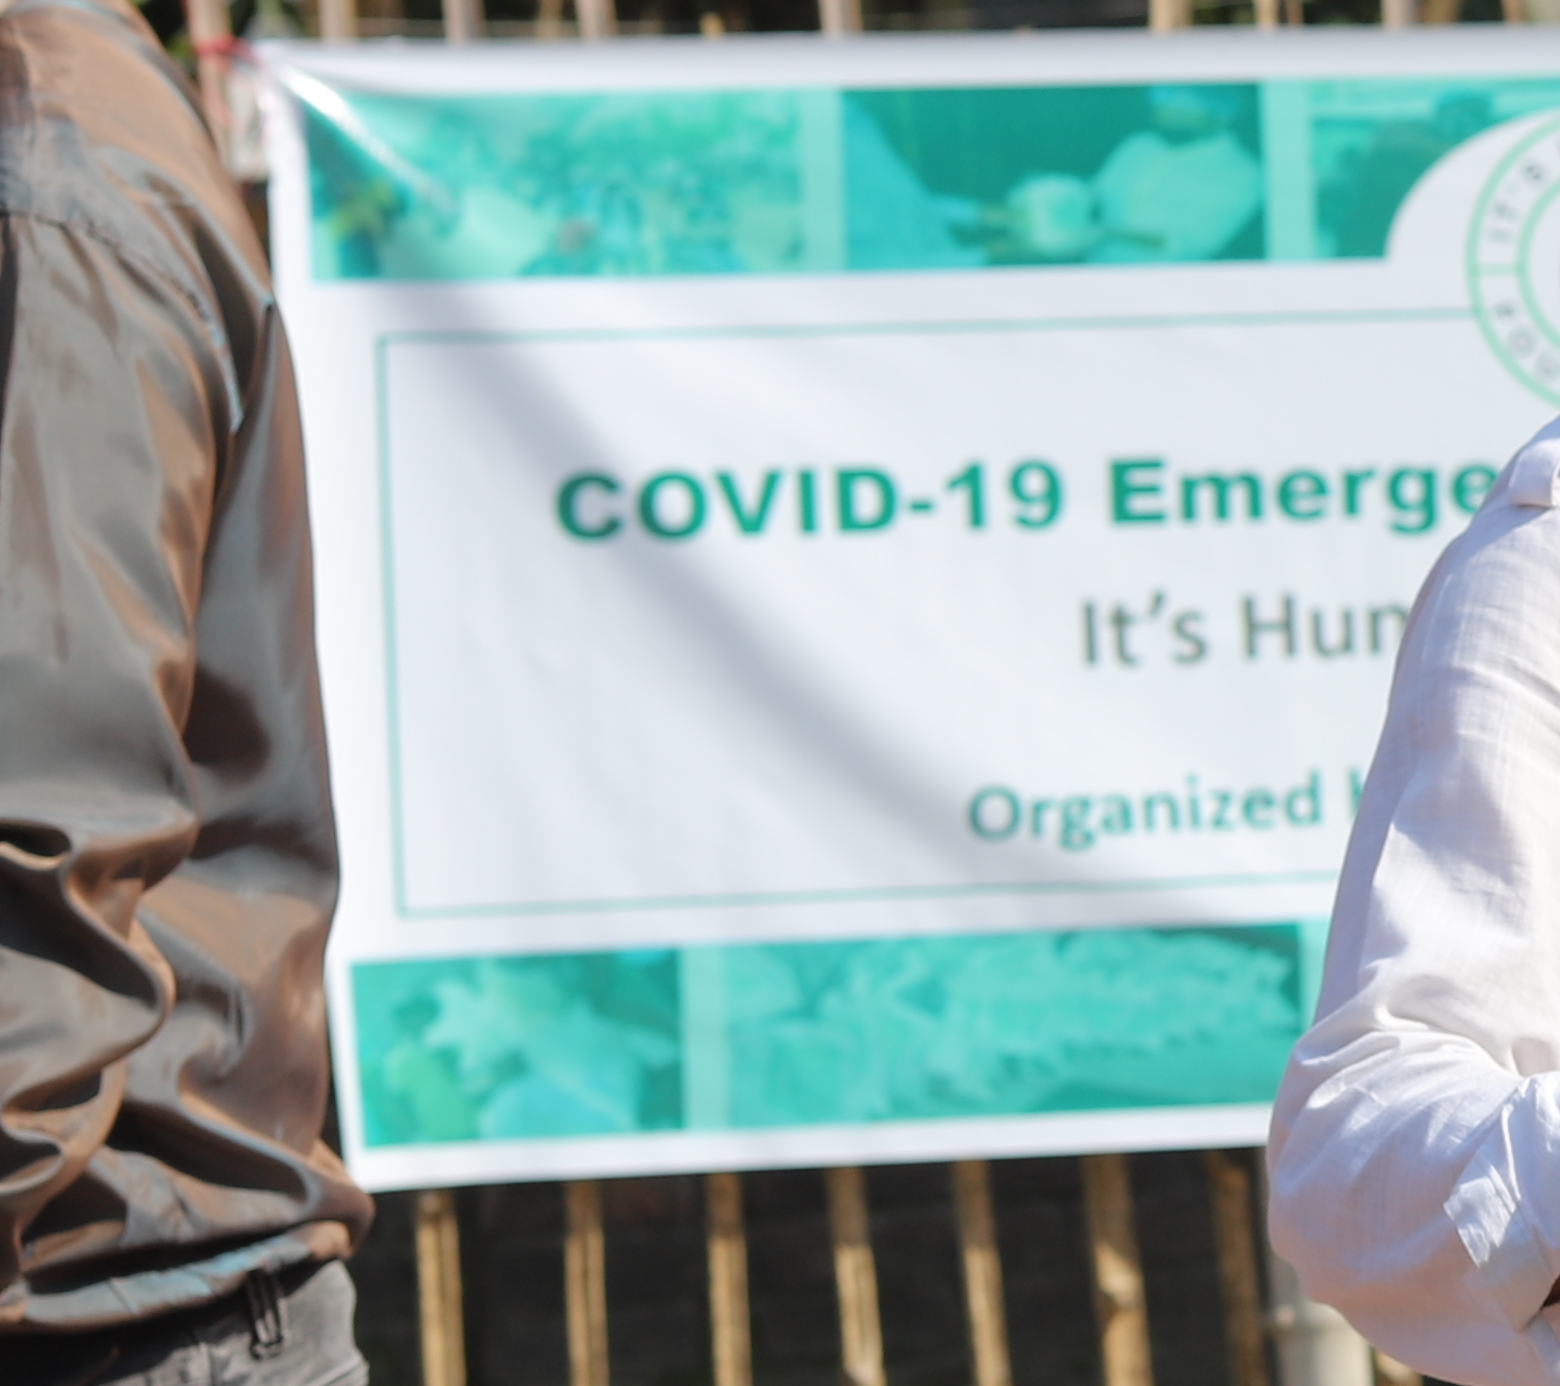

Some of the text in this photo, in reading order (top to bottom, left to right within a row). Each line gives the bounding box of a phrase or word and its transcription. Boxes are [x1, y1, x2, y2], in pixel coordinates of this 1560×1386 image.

[555, 457, 1500, 541] COVID-19 Emerge
[966, 767, 1323, 852] Organized
